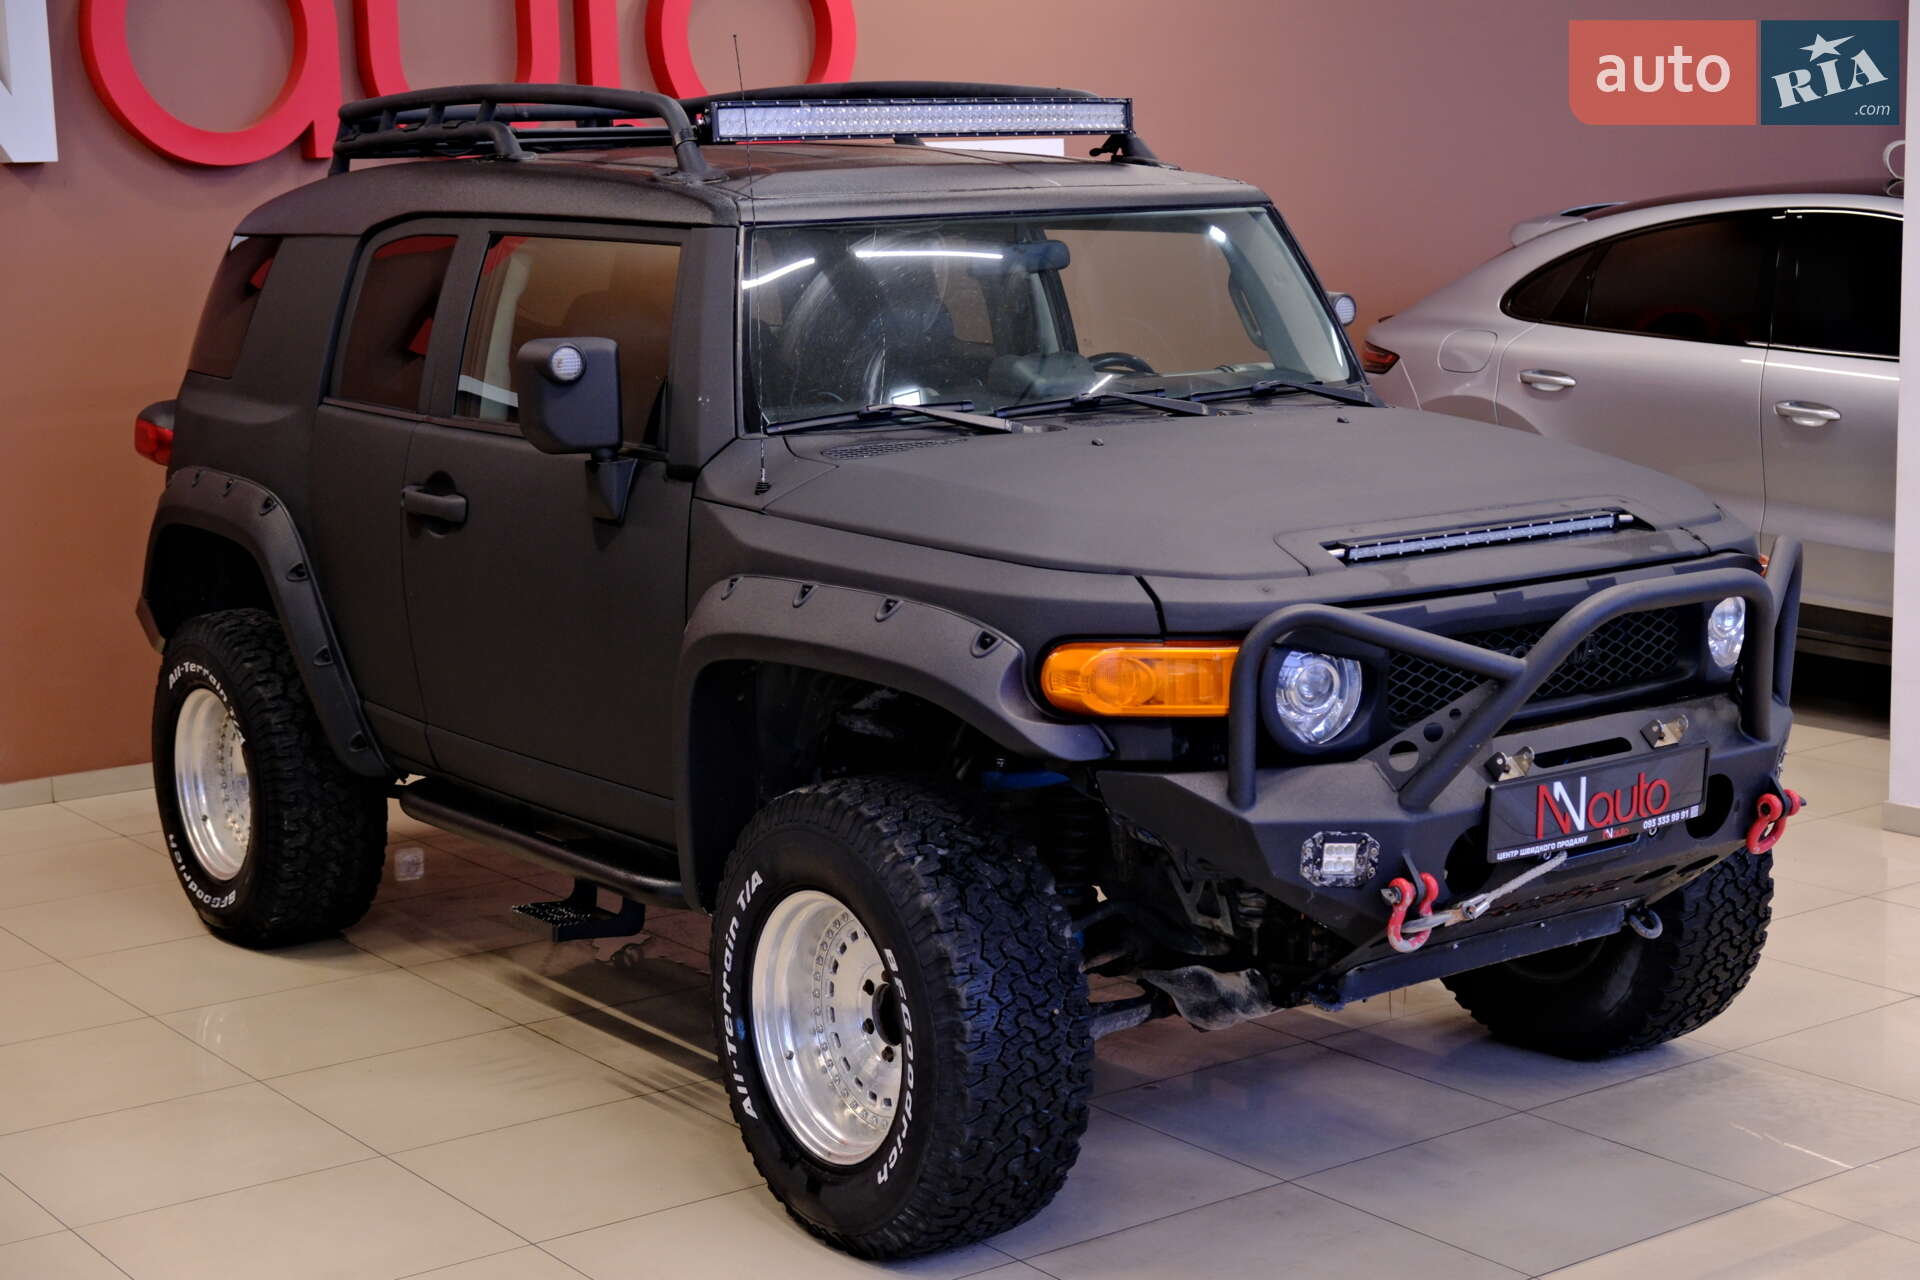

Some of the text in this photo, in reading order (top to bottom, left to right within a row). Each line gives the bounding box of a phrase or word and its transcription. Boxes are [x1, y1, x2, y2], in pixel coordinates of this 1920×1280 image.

[168, 661, 228, 703] All-Terrain
[1496, 836, 1588, 861] ЦЕНТР ШВИДКОГО ПРОДАЖУ
[1657, 814, 1670, 826] 333
[168, 834, 237, 909] BFGoodrich
[722, 869, 764, 1120] All-Terrain T/A
[877, 948, 914, 1185] BFGoodrich
